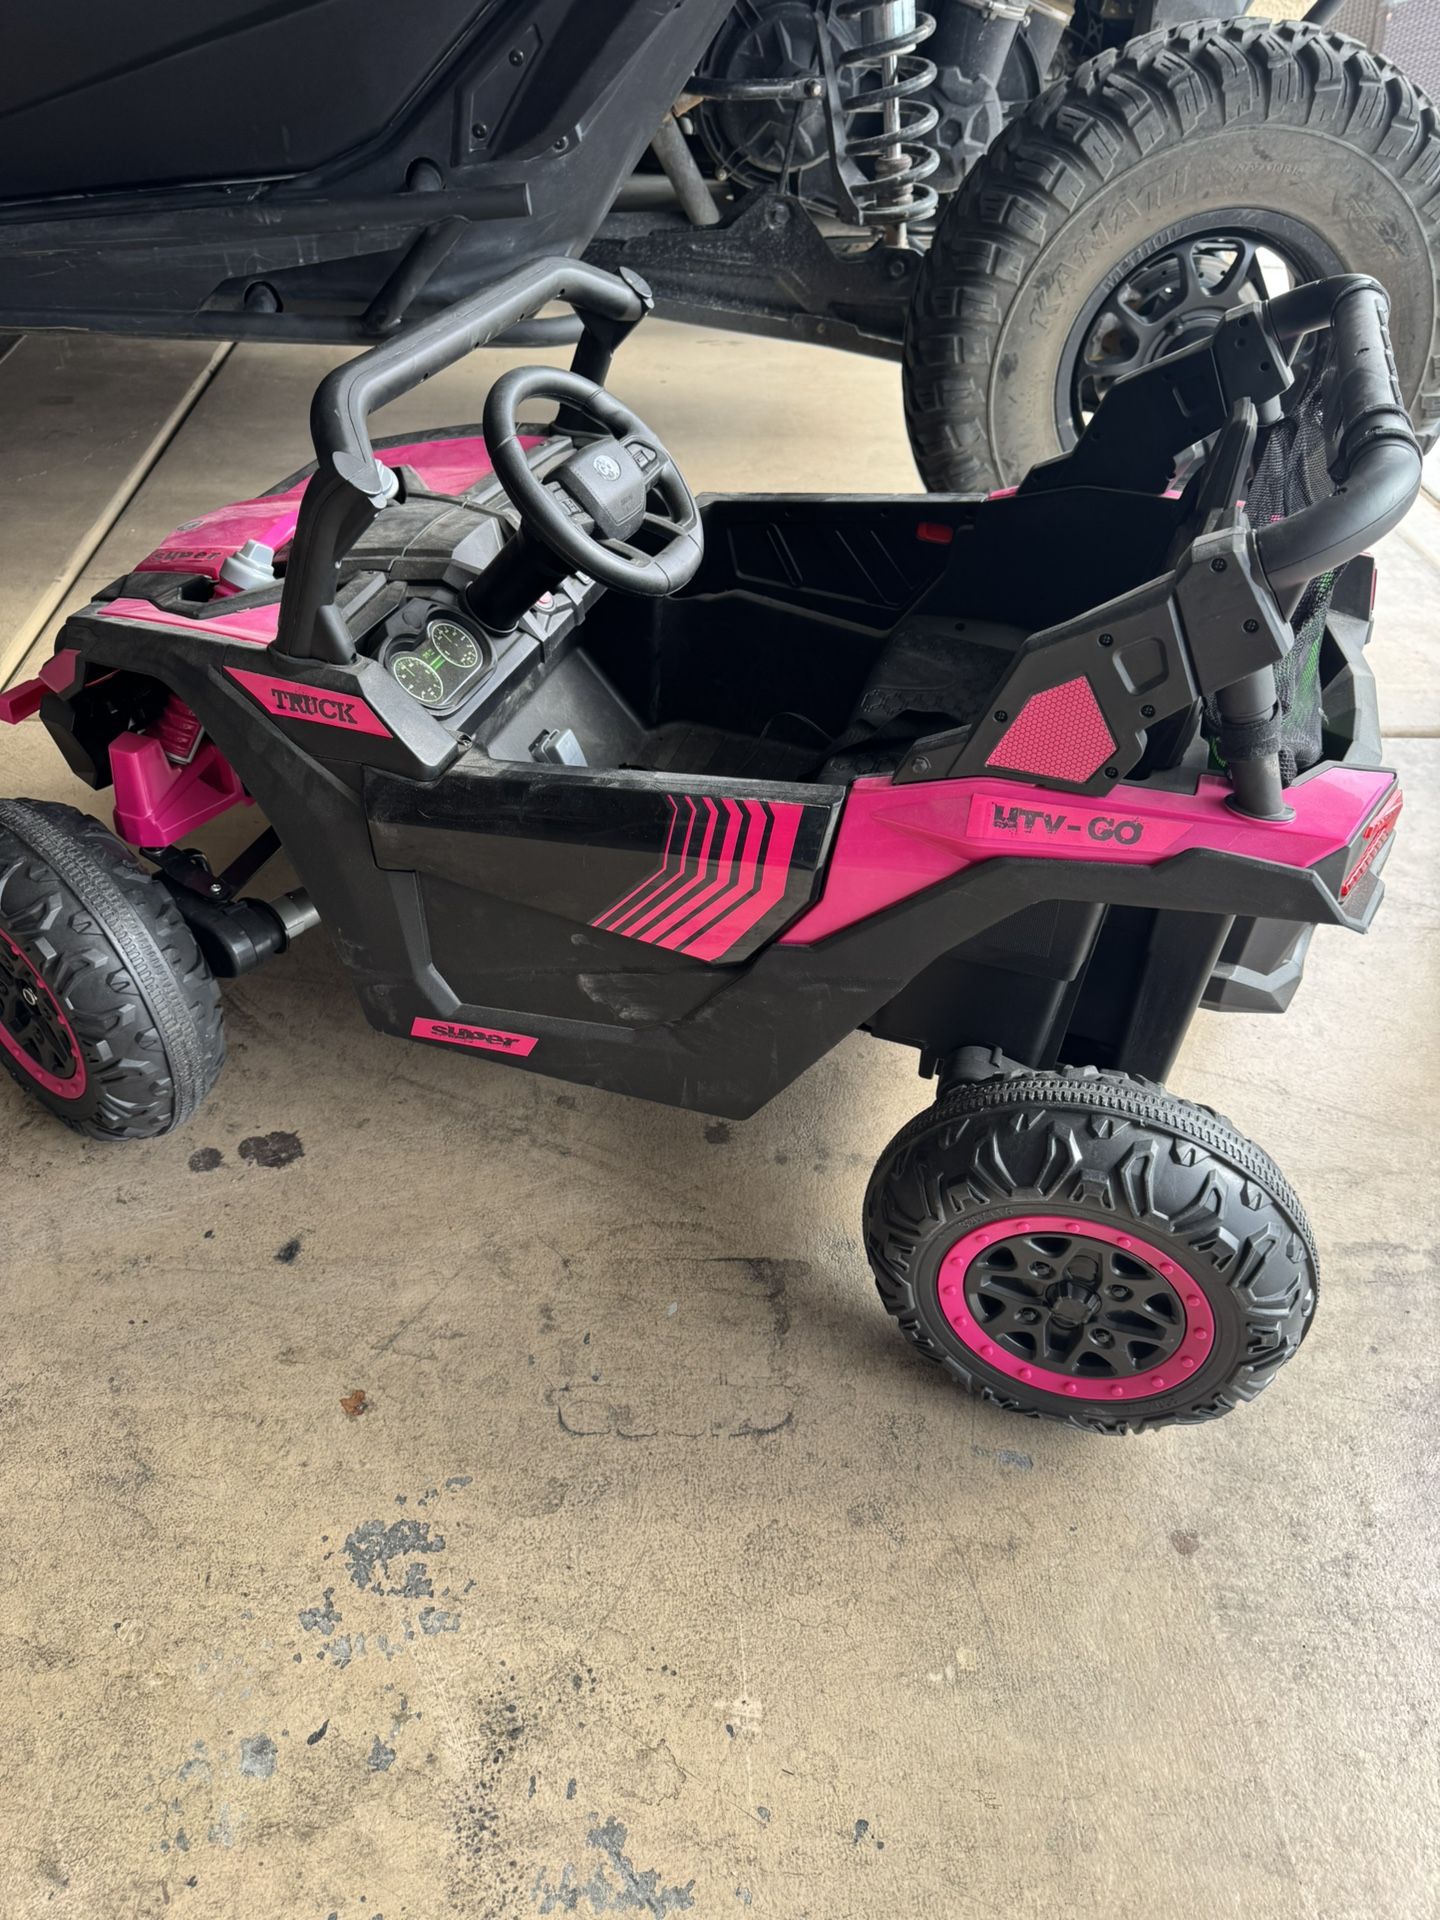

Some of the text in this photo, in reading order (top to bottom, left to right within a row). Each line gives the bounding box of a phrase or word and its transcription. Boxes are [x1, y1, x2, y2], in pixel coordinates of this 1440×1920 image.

[271, 688, 358, 725] TRUCK
[992, 802, 1145, 845] UTV-GO
[431, 1025, 520, 1048] super
